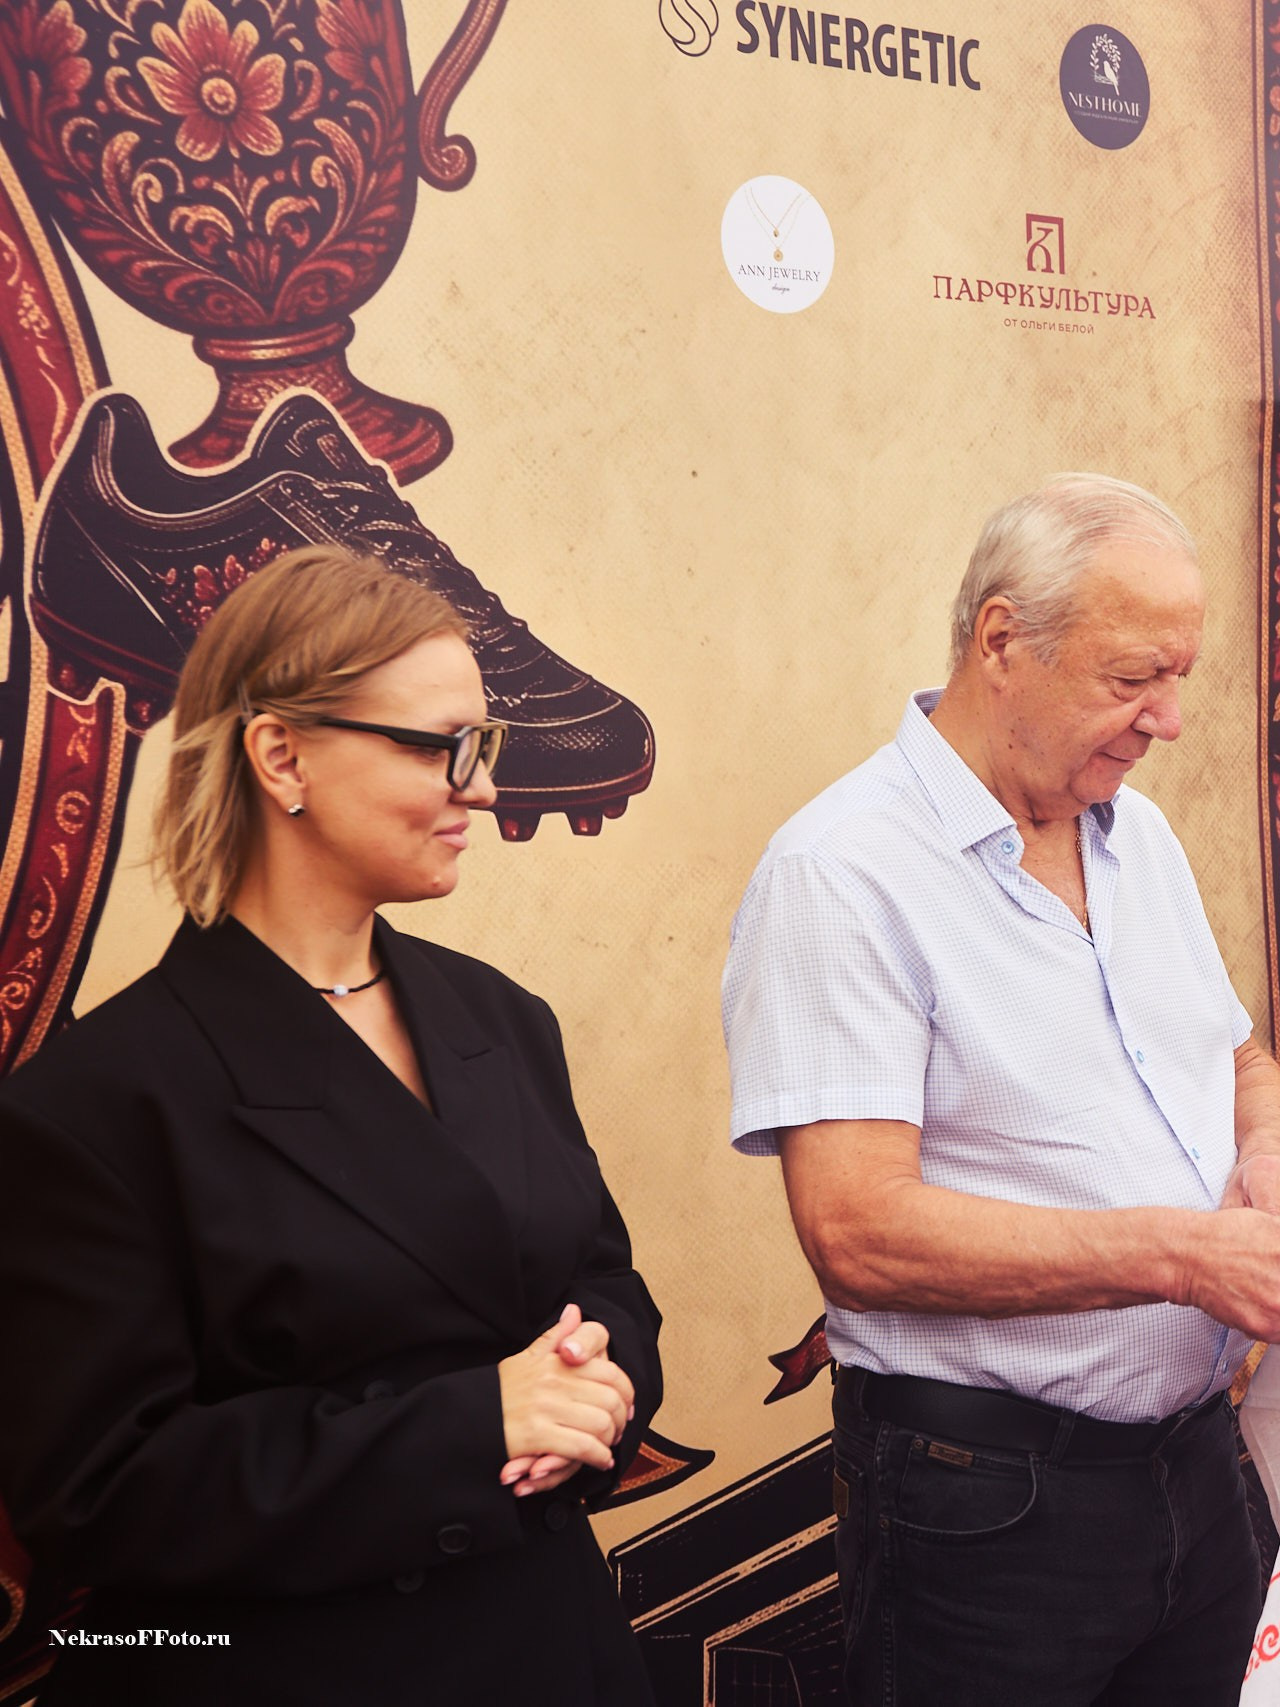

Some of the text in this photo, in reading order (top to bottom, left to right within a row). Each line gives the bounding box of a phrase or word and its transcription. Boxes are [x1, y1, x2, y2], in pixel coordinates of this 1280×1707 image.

[735, 0, 981, 91] SYNERGETIC
[1068, 91, 1142, 118] NESTHOME
[738, 264, 820, 282] ANN JEWELRY
[933, 275, 1157, 319] ПАРФКУЛЬТУРА
[1003, 318, 1094, 334] ОТ ОЛЬГИ БЕЛОЙ
